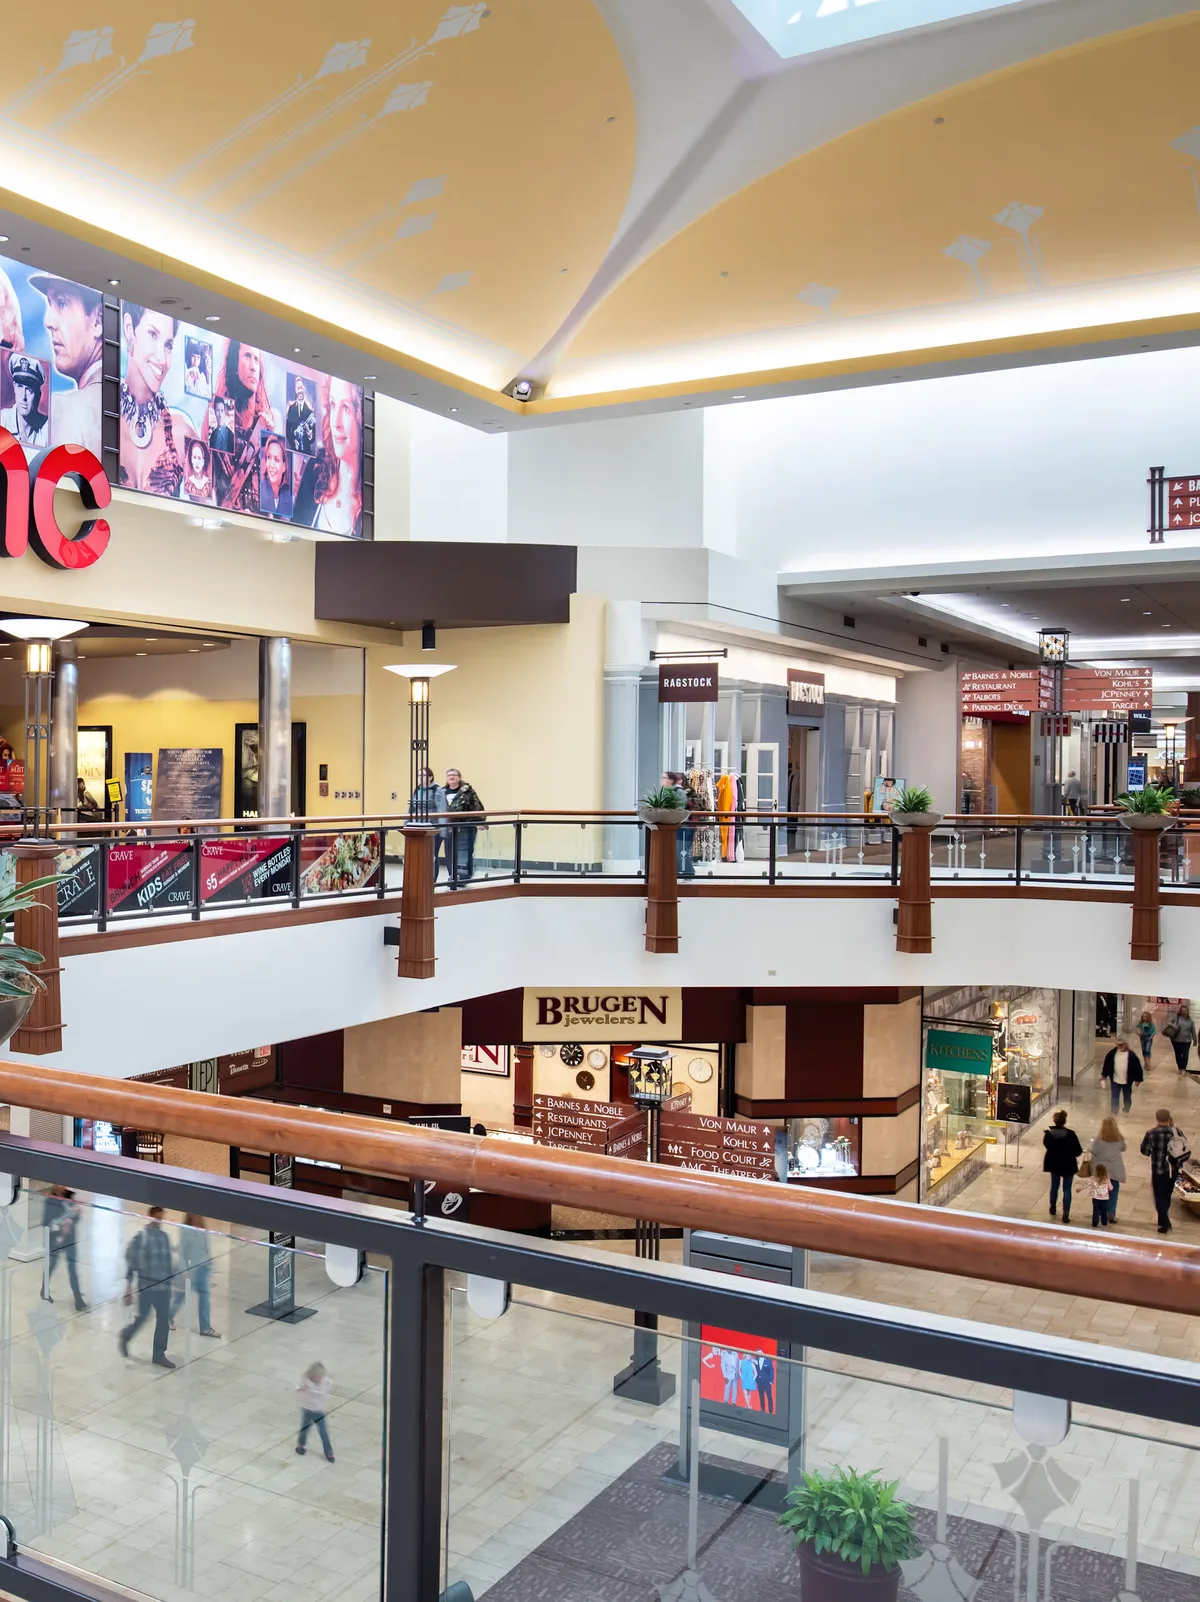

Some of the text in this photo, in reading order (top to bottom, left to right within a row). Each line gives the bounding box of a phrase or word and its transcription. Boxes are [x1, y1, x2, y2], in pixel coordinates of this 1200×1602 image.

[972, 672, 999, 680] BARNES
[1094, 669, 1139, 677] VON MAUR
[663, 677, 712, 688] RAGSTOCK
[1101, 690, 1141, 698] JCPENNEY
[109, 850, 134, 861] CRAVE
[202, 846, 224, 856] CRAVE
[252, 862, 267, 878] WINE
[254, 855, 292, 888] EVERY MONDAY
[57, 866, 95, 906] CRAVE
[110, 873, 140, 903] BRUNCH
[206, 872, 218, 891] $5
[272, 883, 291, 893] CRAVE
[136, 876, 163, 907] KIDS
[168, 891, 191, 902] CRAVE
[536, 996, 669, 1025] BRUGEN
[563, 1014, 636, 1027] jewelers
[930, 1043, 989, 1062] KITCHENS
[547, 1097, 623, 1116] BARNES & NOBLE
[547, 1112, 607, 1128] RESTAURANTS
[699, 1117, 757, 1135] VON MAUR
[547, 1127, 593, 1141] JCPENNEY
[613, 1140, 627, 1153] BARNES
[631, 1131, 643, 1145] NOBLE
[723, 1136, 757, 1150] KOHL'S
[691, 1147, 757, 1166] FOOD COURT
[680, 1161, 706, 1172] AMC
